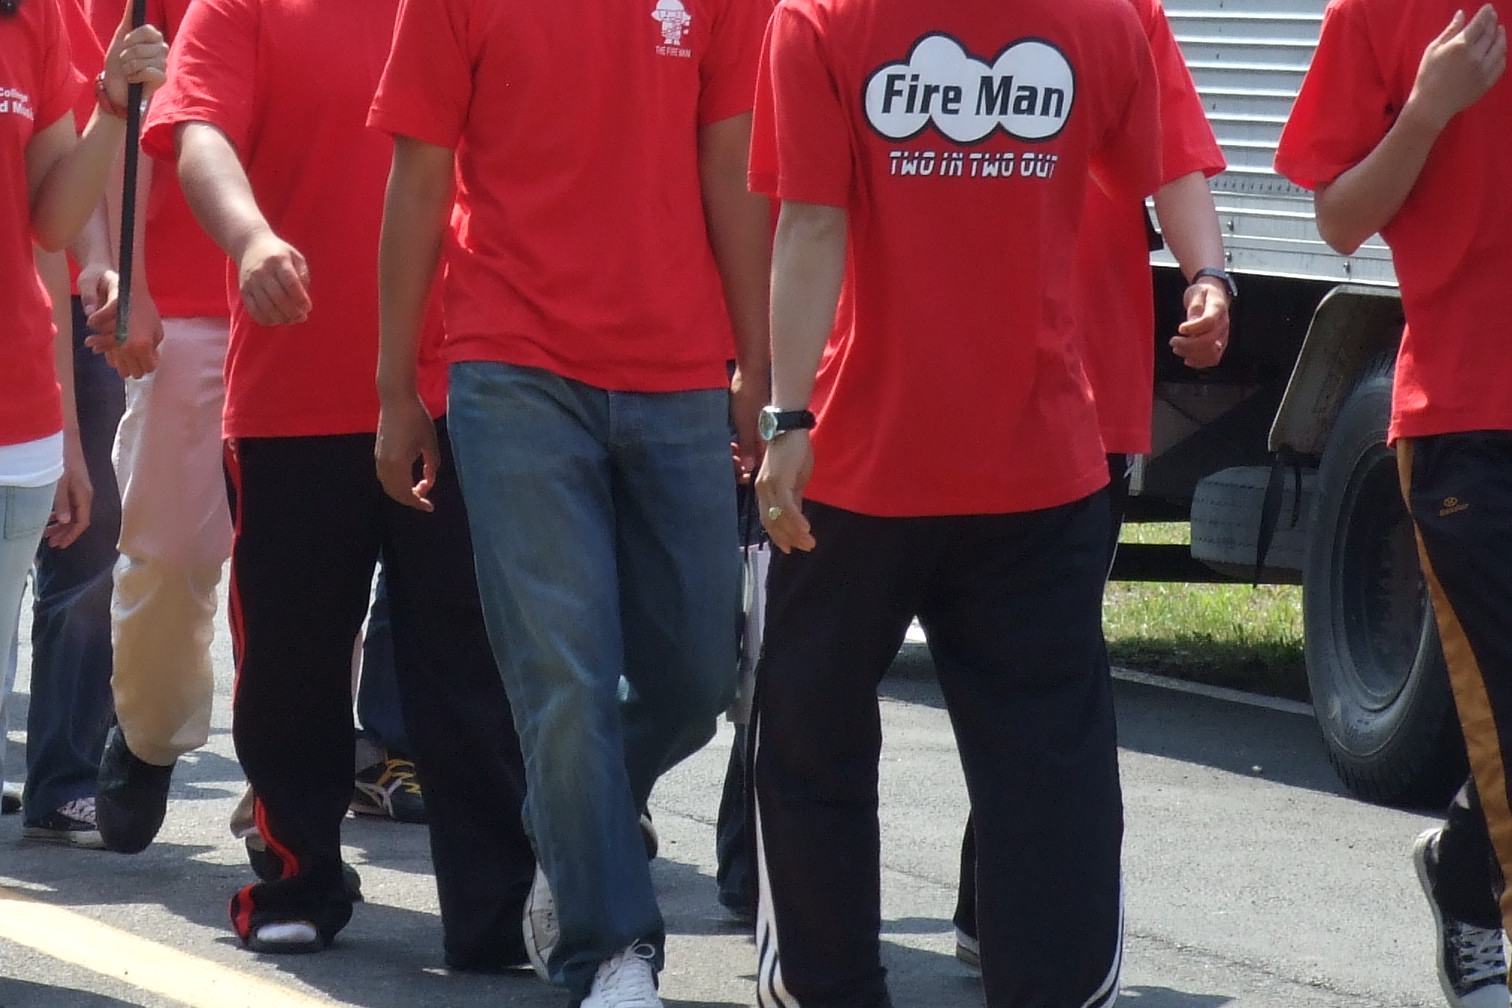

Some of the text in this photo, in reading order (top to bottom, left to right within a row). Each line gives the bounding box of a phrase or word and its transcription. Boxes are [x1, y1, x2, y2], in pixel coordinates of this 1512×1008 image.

[881, 74, 1065, 118] Fire Man
[889, 150, 936, 176] TWO
[969, 152, 1015, 178] TWO
